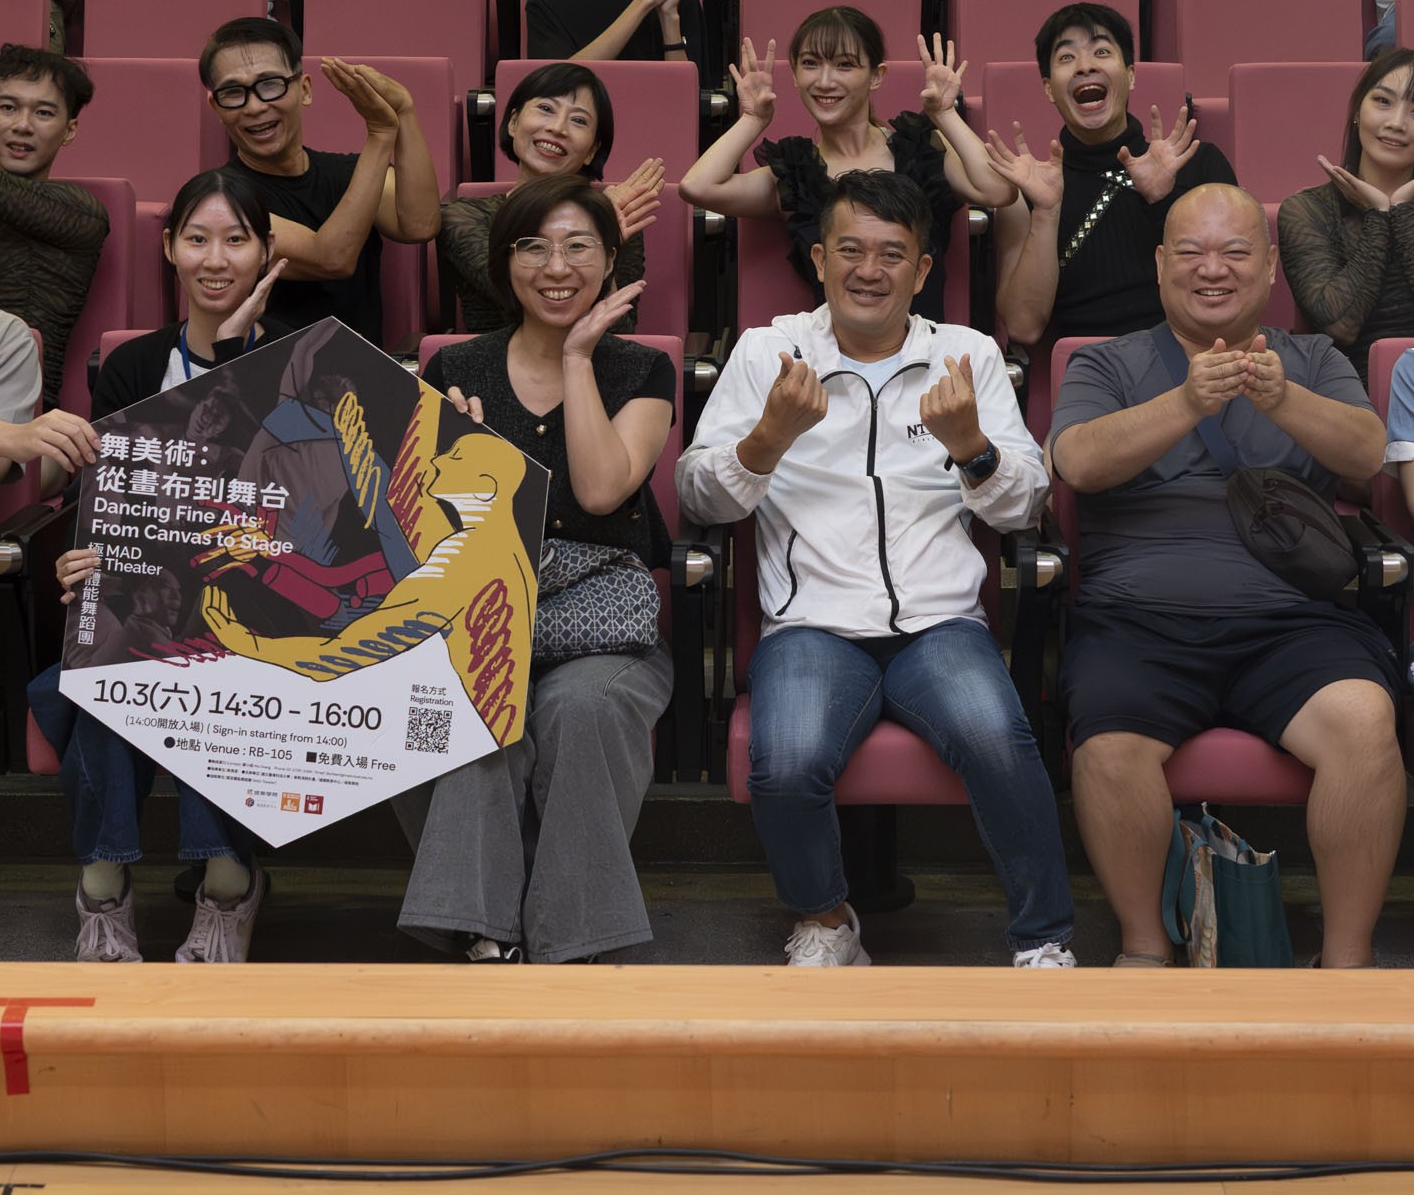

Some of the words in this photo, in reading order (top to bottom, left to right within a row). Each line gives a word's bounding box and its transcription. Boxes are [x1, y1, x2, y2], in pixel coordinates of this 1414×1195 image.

[95, 465, 290, 509] 從畫布到舞台
[93, 496, 171, 523] Dancing
[175, 505, 216, 524] Fine
[219, 510, 263, 529] Arts:
[91, 519, 139, 538] From
[144, 524, 212, 546] Canvas
[217, 532, 235, 548] to
[239, 533, 294, 556] Stage
[105, 544, 142, 560] MAD
[104, 557, 163, 576] Theater
[77, 541, 105, 645] 極體能舞蹈團
[410, 694, 454, 707] Registration
[411, 684, 447, 696] 報名方式
[93, 679, 202, 716] 10.3(六)
[208, 691, 282, 720] 14:30
[308, 701, 382, 731] 16:00
[212, 724, 248, 738] Sign-in
[249, 728, 288, 743] starting
[289, 733, 313, 744] from
[316, 735, 348, 749] 14:00)
[204, 741, 240, 755] Venue
[249, 746, 293, 761] RB-105
[371, 758, 396, 772] Free
